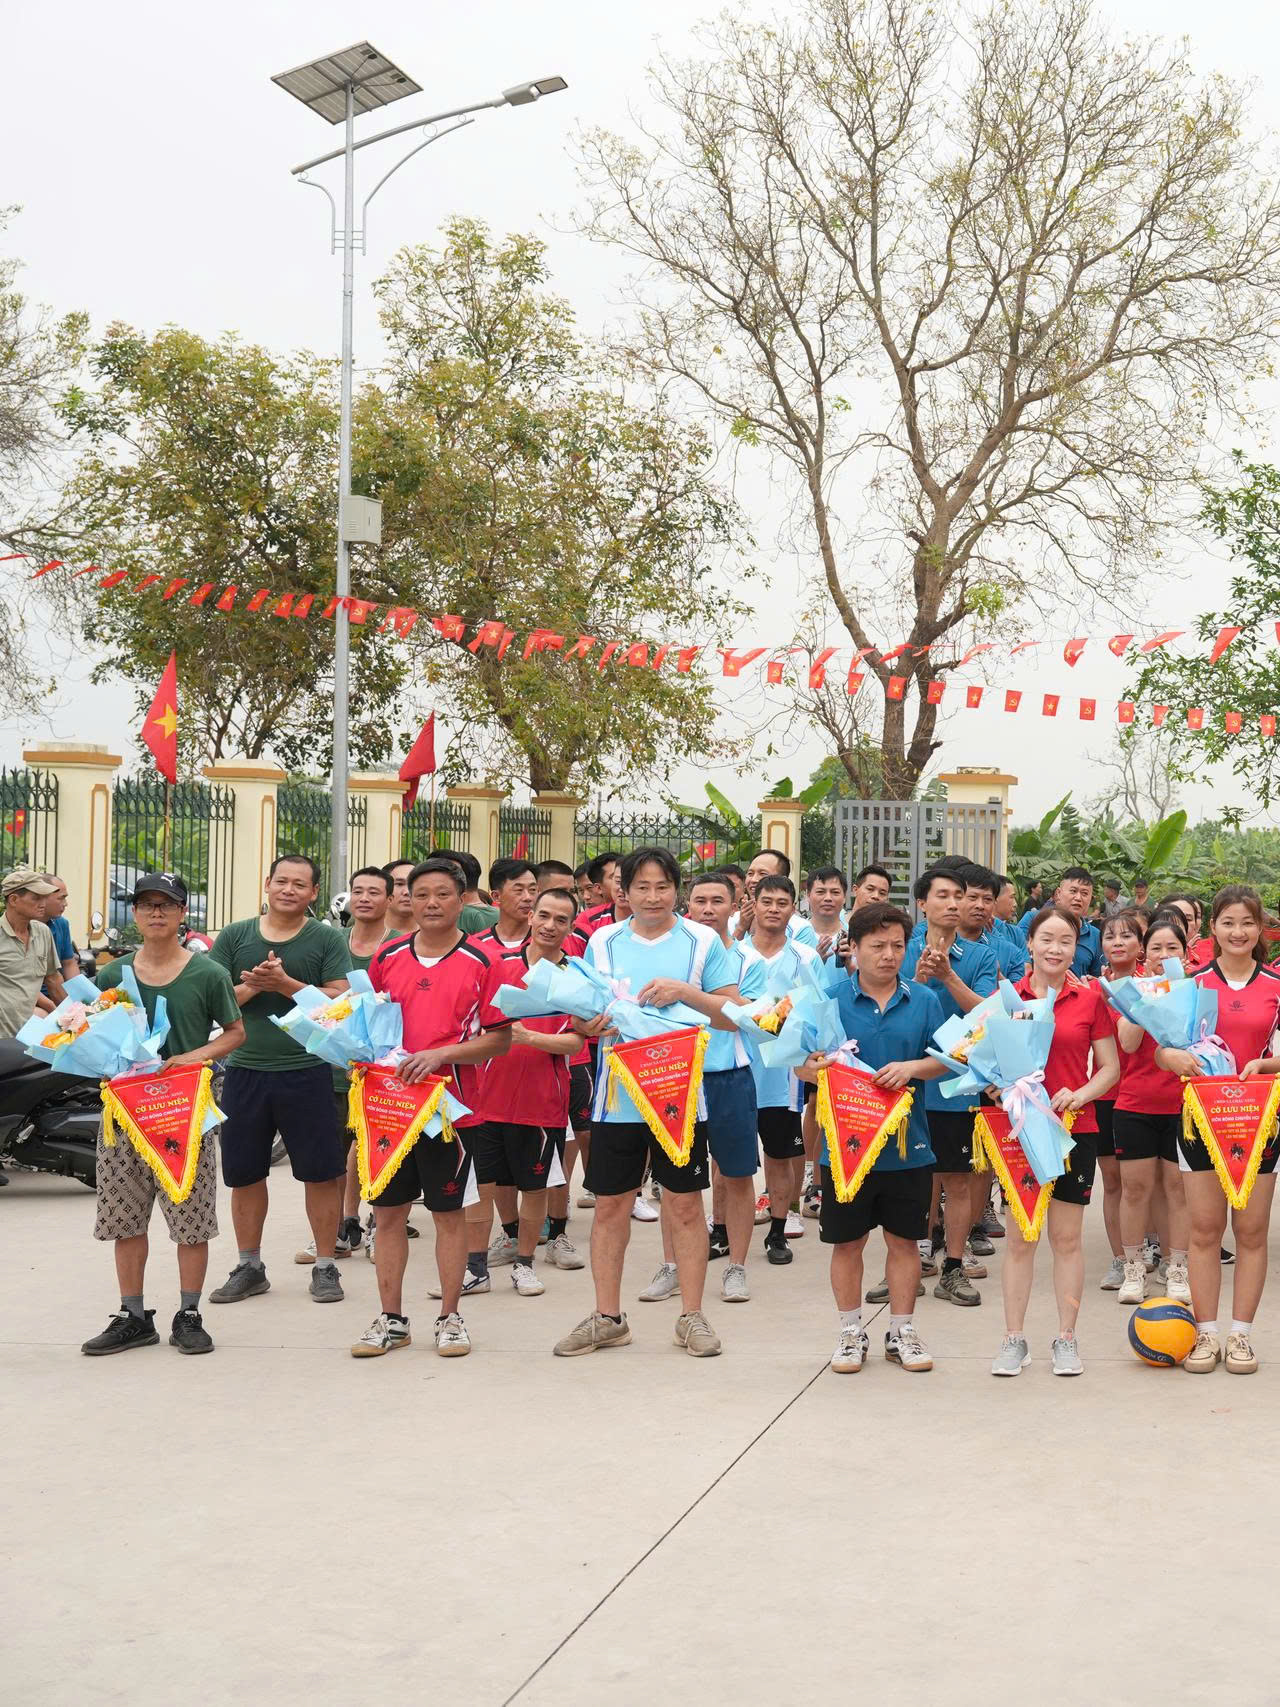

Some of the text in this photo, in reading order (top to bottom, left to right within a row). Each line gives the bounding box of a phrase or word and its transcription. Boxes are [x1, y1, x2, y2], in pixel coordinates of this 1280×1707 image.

[650, 1065, 667, 1075] LƯU
[667, 1061, 688, 1071] NIỆM
[147, 1101, 166, 1111] LƯU
[167, 1096, 189, 1107] NIỆM
[378, 1096, 395, 1106] LƯU
[395, 1100, 416, 1110] NIỆM
[848, 1095, 866, 1105] LƯU
[866, 1100, 886, 1110] NIỆM
[1222, 1105, 1238, 1113] LƯU
[1240, 1104, 1259, 1113] NIỆM
